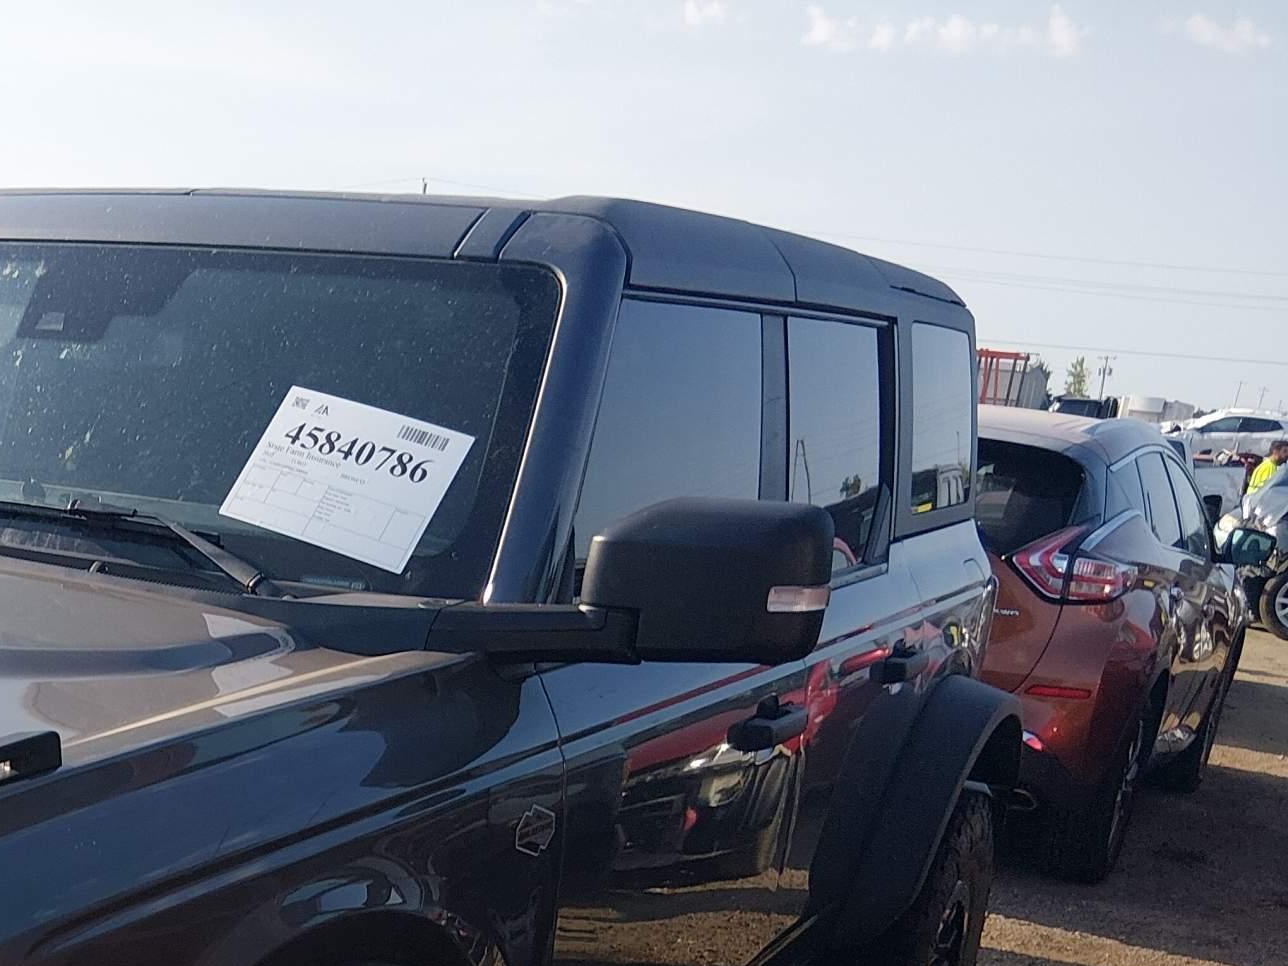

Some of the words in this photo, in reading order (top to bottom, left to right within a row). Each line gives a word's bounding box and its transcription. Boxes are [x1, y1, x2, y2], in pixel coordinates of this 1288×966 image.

[268, 442, 285, 452] State
[286, 446, 306, 458] Farm
[306, 450, 342, 469] Insurance
[284, 422, 435, 484] 45840786
